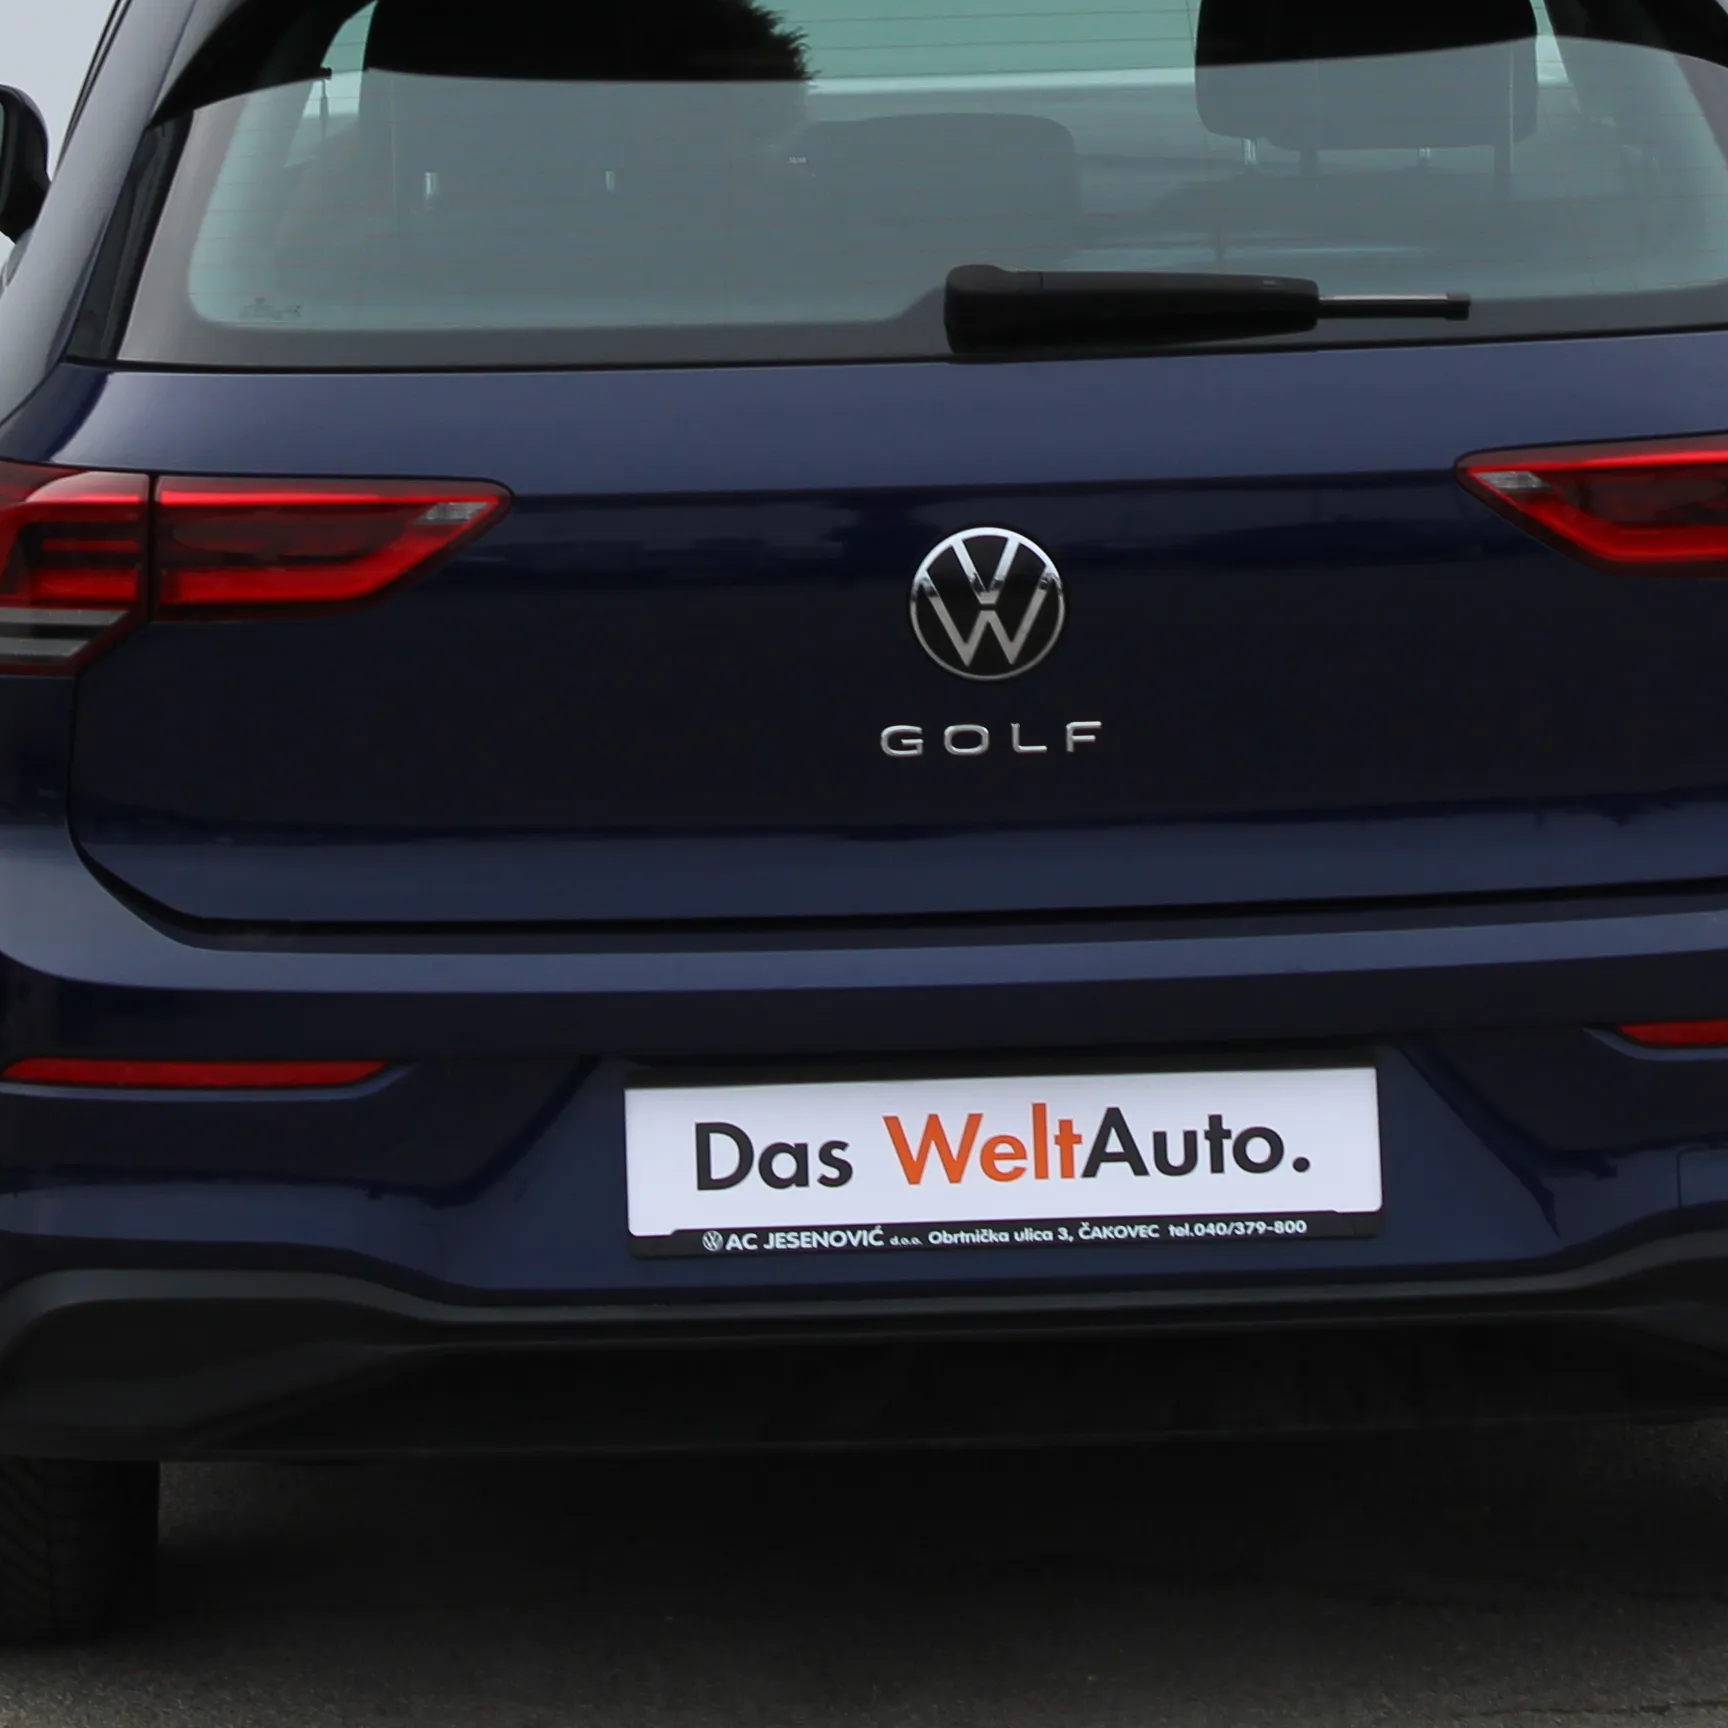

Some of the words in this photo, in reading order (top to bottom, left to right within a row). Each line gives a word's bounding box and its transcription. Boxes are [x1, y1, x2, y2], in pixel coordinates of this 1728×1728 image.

[879, 720, 1103, 758] GOLF
[695, 1121, 853, 1191] Das
[882, 1102, 1311, 1185] WeltAuto.
[725, 1233, 758, 1251] AC
[763, 1225, 884, 1250] JESENOVIĆ
[928, 1227, 1010, 1245] Obrtnička
[1013, 1226, 1054, 1243] ulica
[1078, 1221, 1160, 1240] ČAKOVEC
